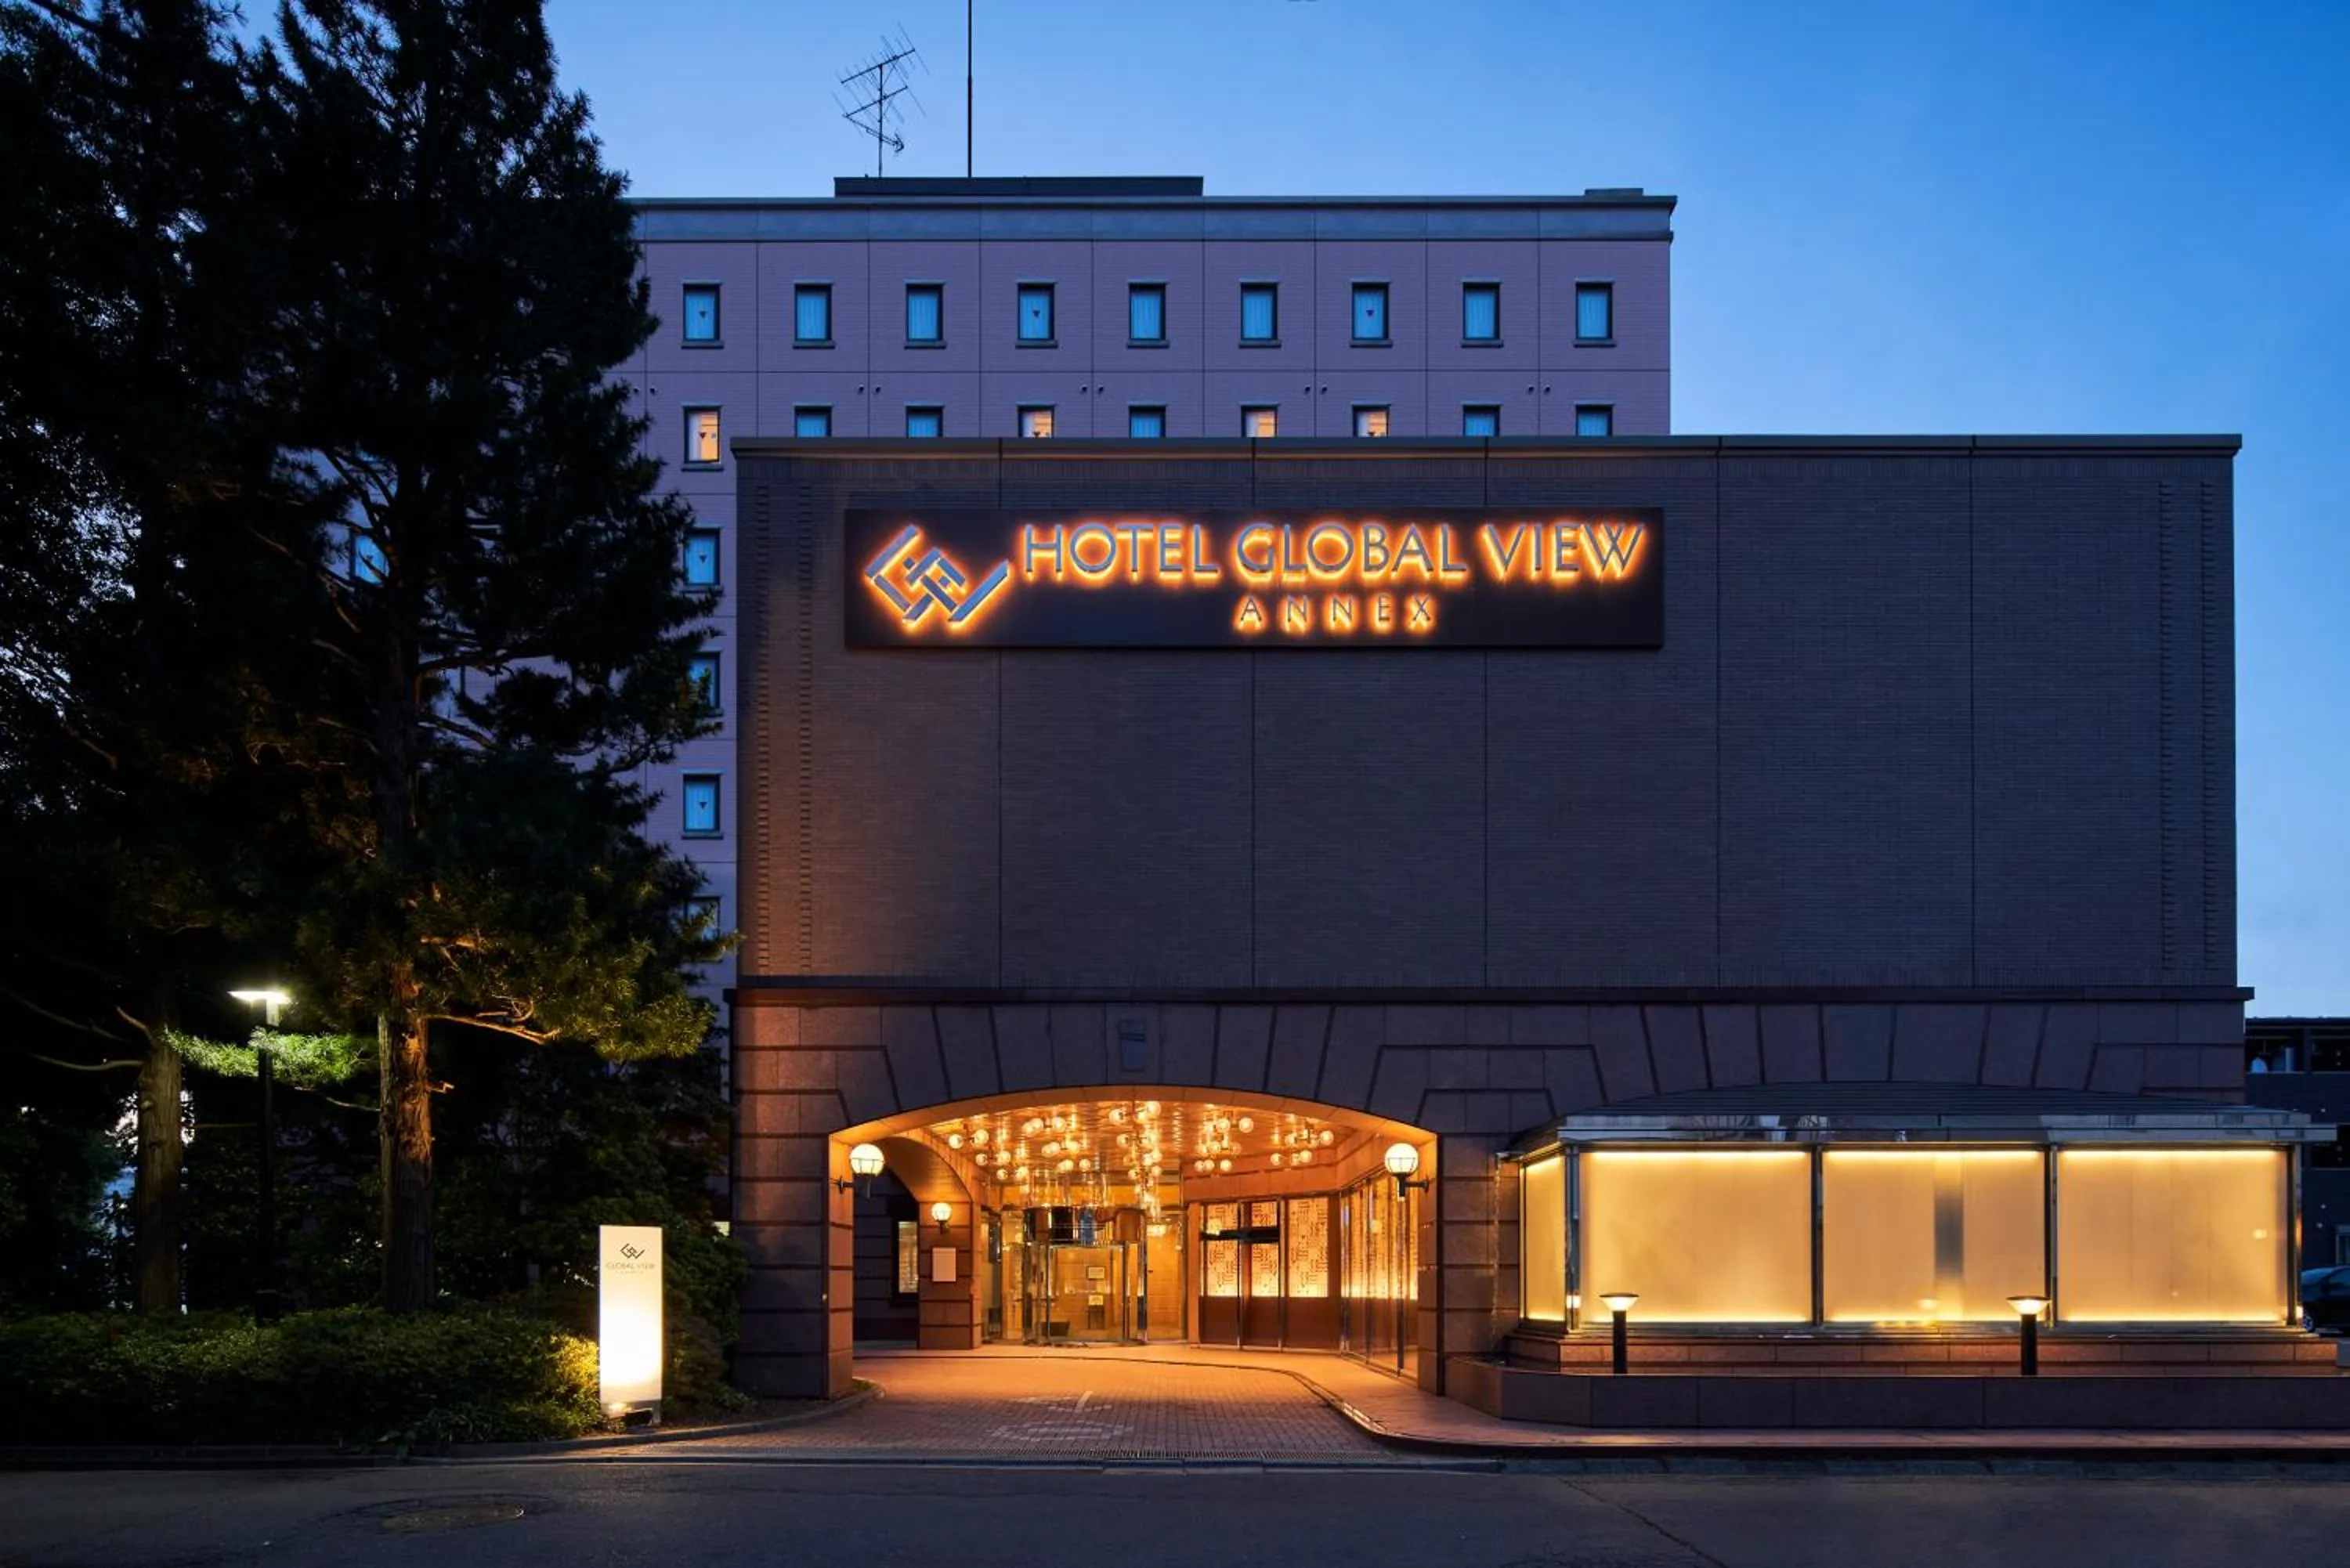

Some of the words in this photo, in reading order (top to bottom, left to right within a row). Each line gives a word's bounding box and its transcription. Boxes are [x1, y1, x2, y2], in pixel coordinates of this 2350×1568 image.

[1024, 522, 1219, 574] HOTEL
[1237, 522, 1467, 574] GLOBAL
[1483, 522, 1646, 573] VIEW
[1239, 594, 1433, 624] ANNEX
